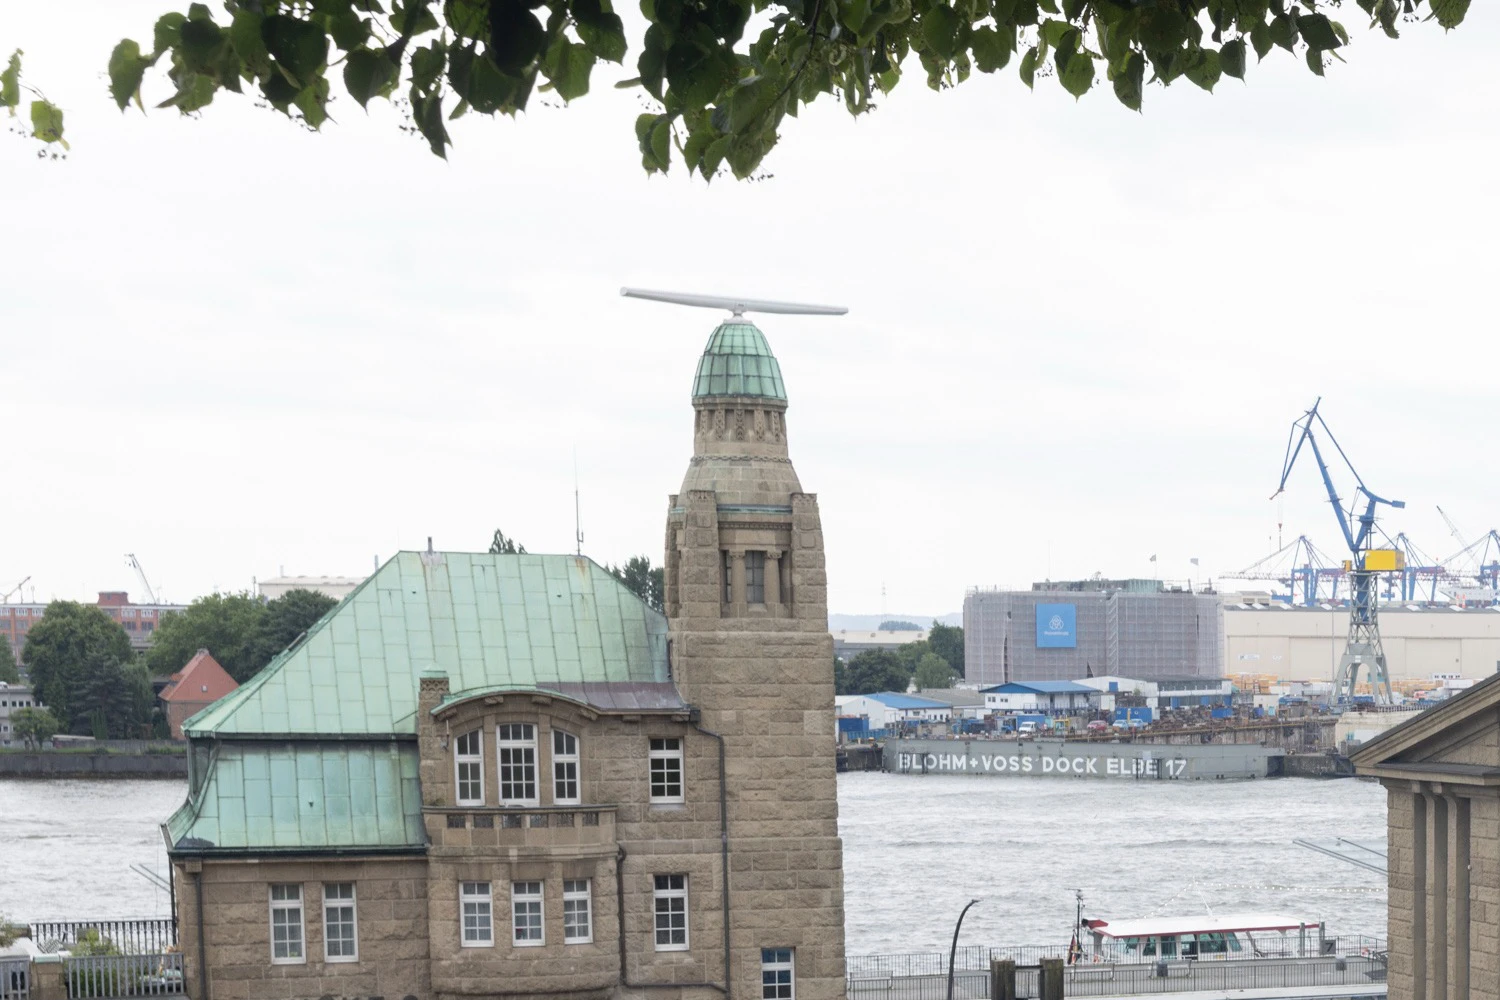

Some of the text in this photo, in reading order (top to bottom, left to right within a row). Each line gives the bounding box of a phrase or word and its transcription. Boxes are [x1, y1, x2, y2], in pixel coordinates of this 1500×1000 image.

[1042, 757, 1098, 774] DOCK
[1106, 758, 1158, 776] ELBE
[1165, 759, 1187, 776] 17
[1325, 942, 1334, 953] 7
